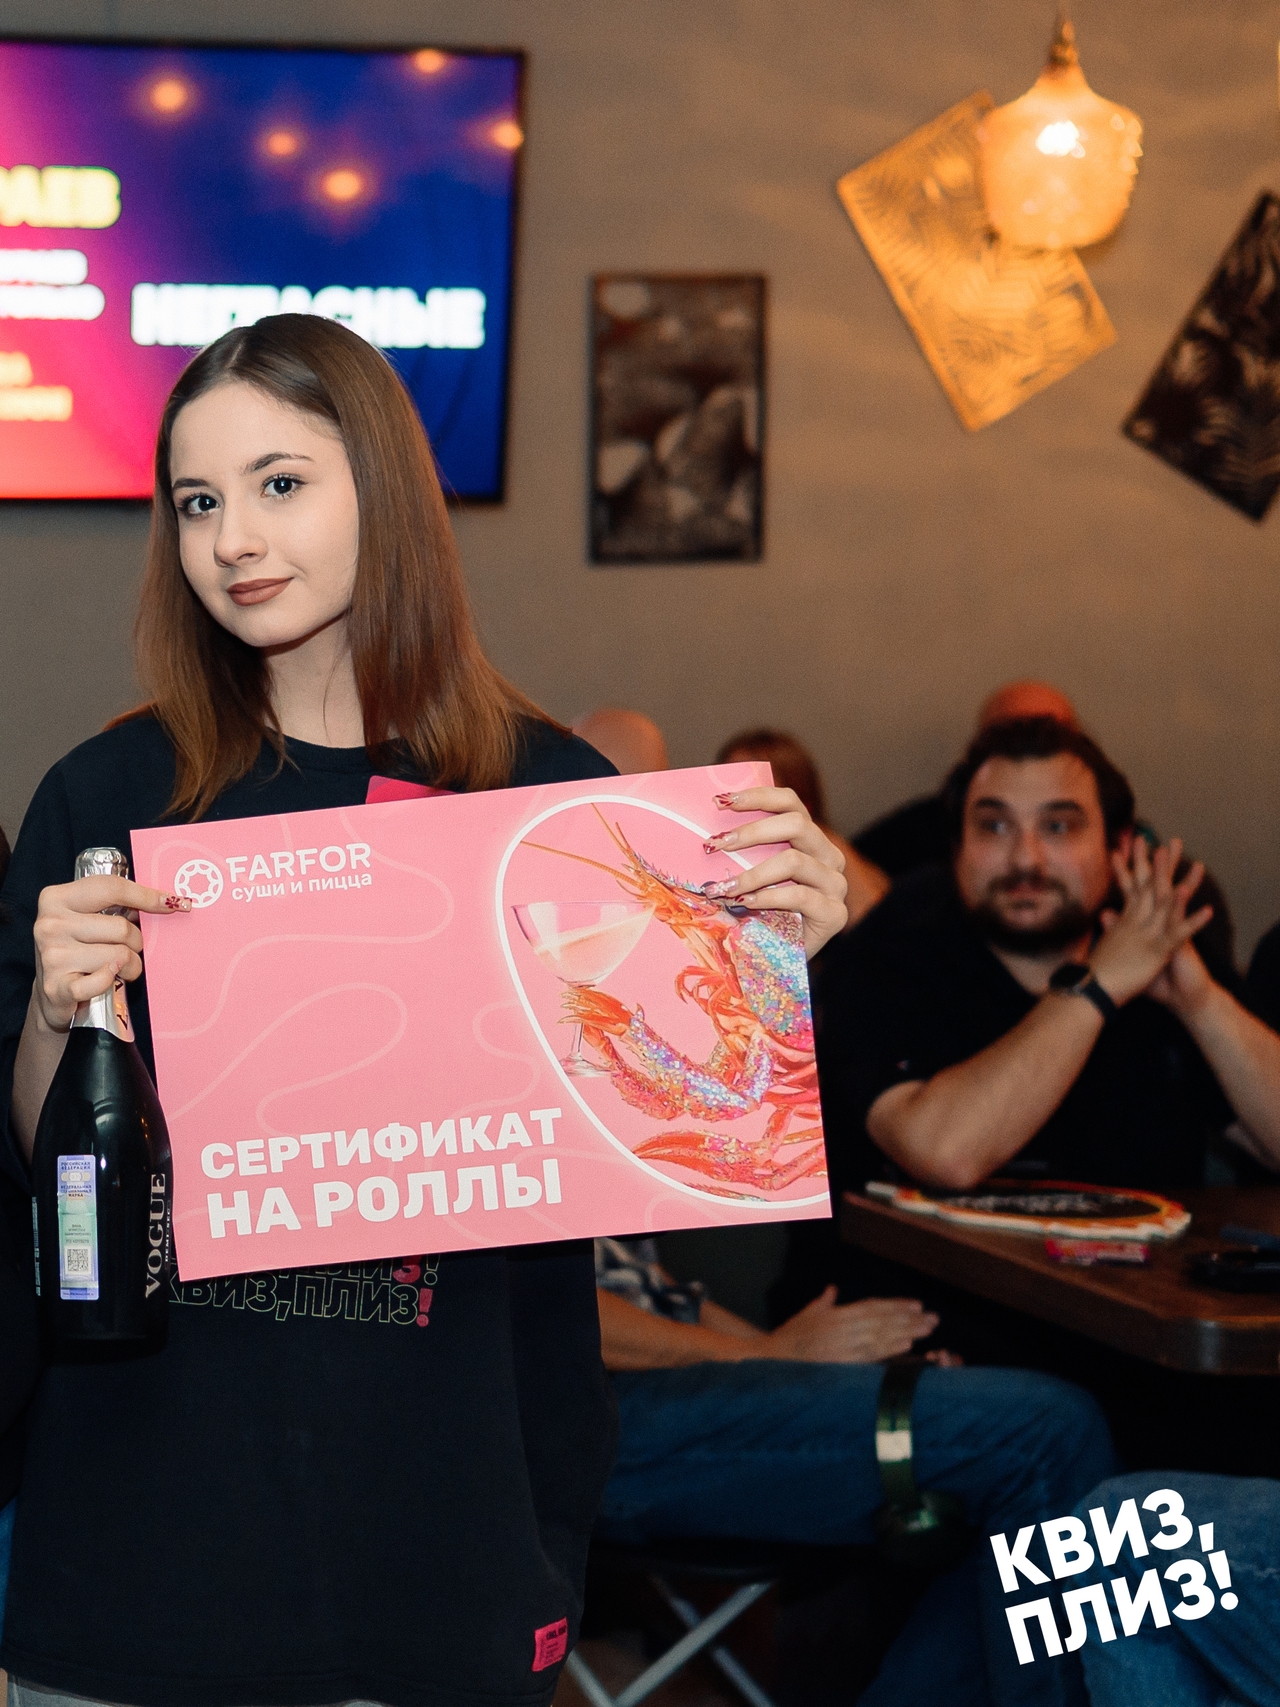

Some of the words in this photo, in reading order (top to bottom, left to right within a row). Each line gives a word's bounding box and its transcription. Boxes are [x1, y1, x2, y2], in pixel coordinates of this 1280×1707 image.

[225, 842, 371, 883] FARFOR
[231, 883, 285, 903] суши
[290, 880, 303, 894] и
[308, 873, 373, 892] пицца
[200, 1107, 562, 1179] СЕРТИФИКАТ
[206, 1187, 302, 1239] НА
[313, 1158, 562, 1228] РОЛЛЫ
[146, 1173, 166, 1298] VOGUE
